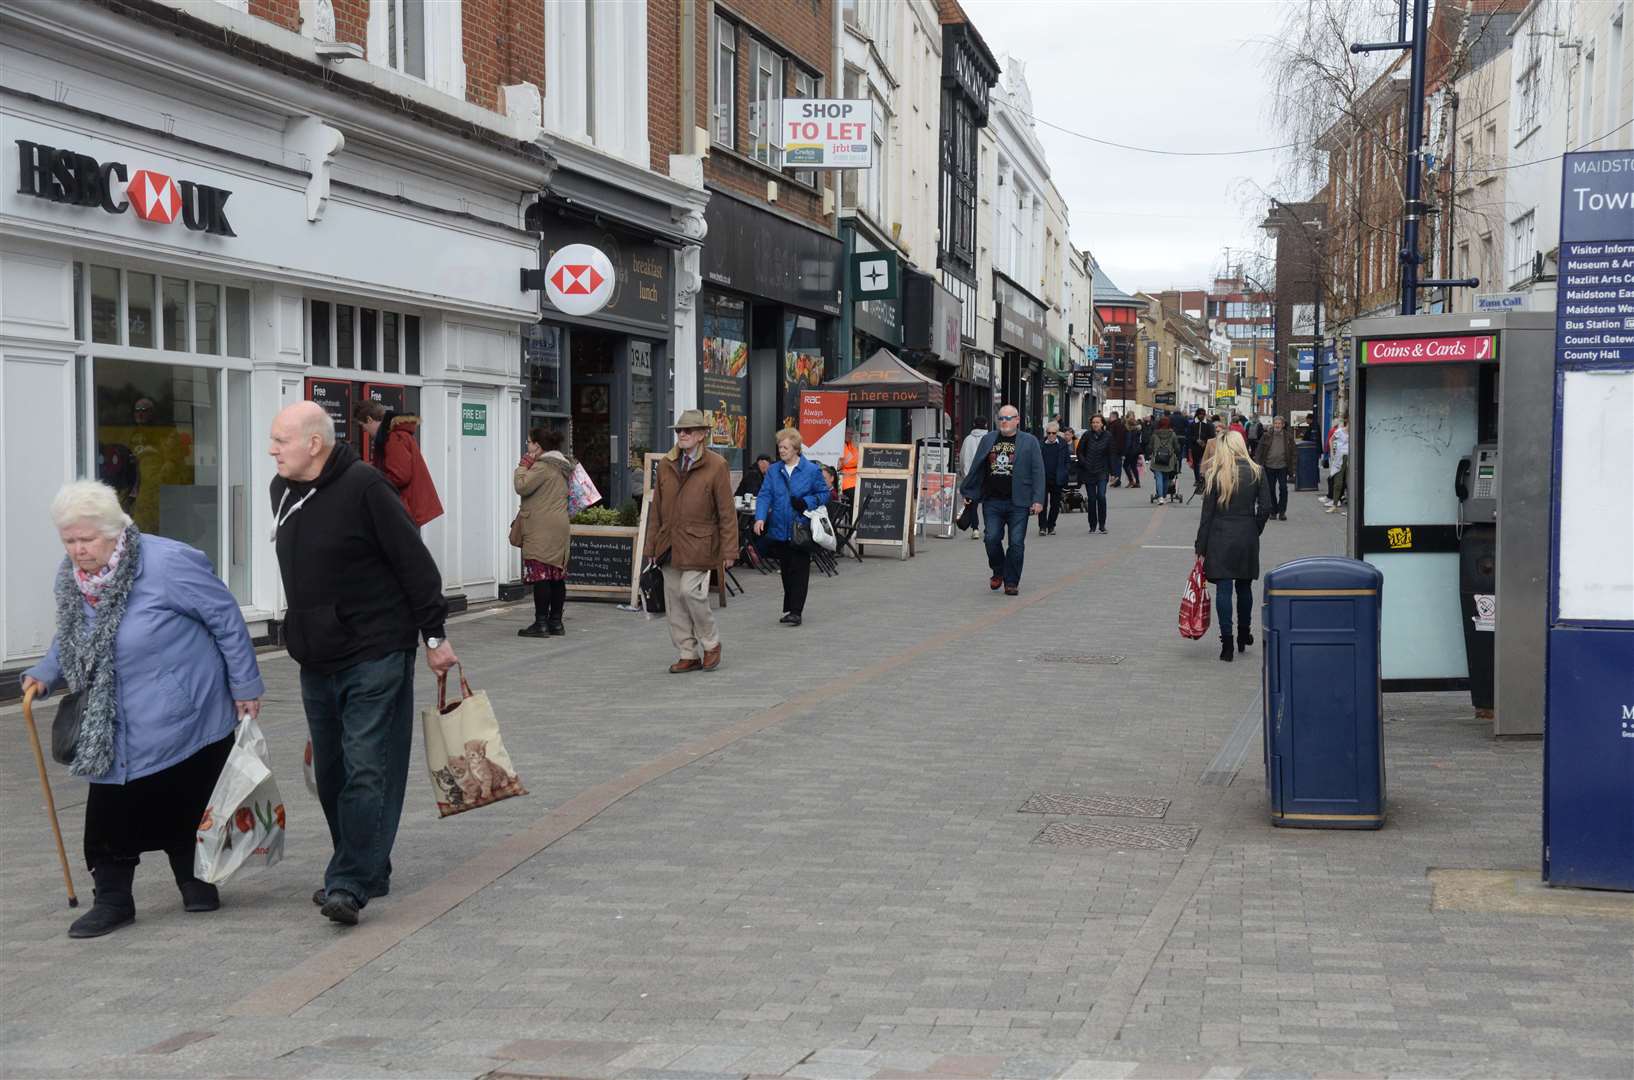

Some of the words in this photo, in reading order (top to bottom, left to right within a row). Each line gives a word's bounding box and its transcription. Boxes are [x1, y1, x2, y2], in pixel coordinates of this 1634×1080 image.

[802, 103, 853, 118] SHOP
[788, 121, 819, 140] TO
[826, 122, 866, 140] LET
[15, 140, 129, 214] HSBC
[177, 180, 237, 237] UK
[1573, 187, 1634, 211] Tow
[1571, 245, 1602, 255] Visitor
[1568, 260, 1609, 270] Museum
[1611, 259, 1620, 268] &
[1567, 275, 1599, 284] Hazlitt
[1601, 274, 1622, 284] Arts
[639, 280, 658, 303] lunch
[1566, 290, 1616, 300] Maidstone
[1566, 305, 1616, 315] Maidstone
[1565, 320, 1584, 330] Bus
[1586, 319, 1620, 329] Station
[1564, 335, 1601, 345] Council
[1603, 334, 1634, 344] Gatew
[1373, 342, 1410, 358] Coins
[1412, 343, 1424, 357] &
[1426, 340, 1466, 357] Cards
[1564, 351, 1598, 361] County
[1600, 350, 1620, 359] Hall
[313, 384, 326, 397] Free
[371, 390, 382, 401] Free
[861, 390, 889, 401] here
[892, 391, 918, 401] now
[463, 408, 474, 419] FIRE
[475, 409, 486, 420] EXIT
[803, 408, 824, 417] Always
[803, 418, 832, 426] innovating
